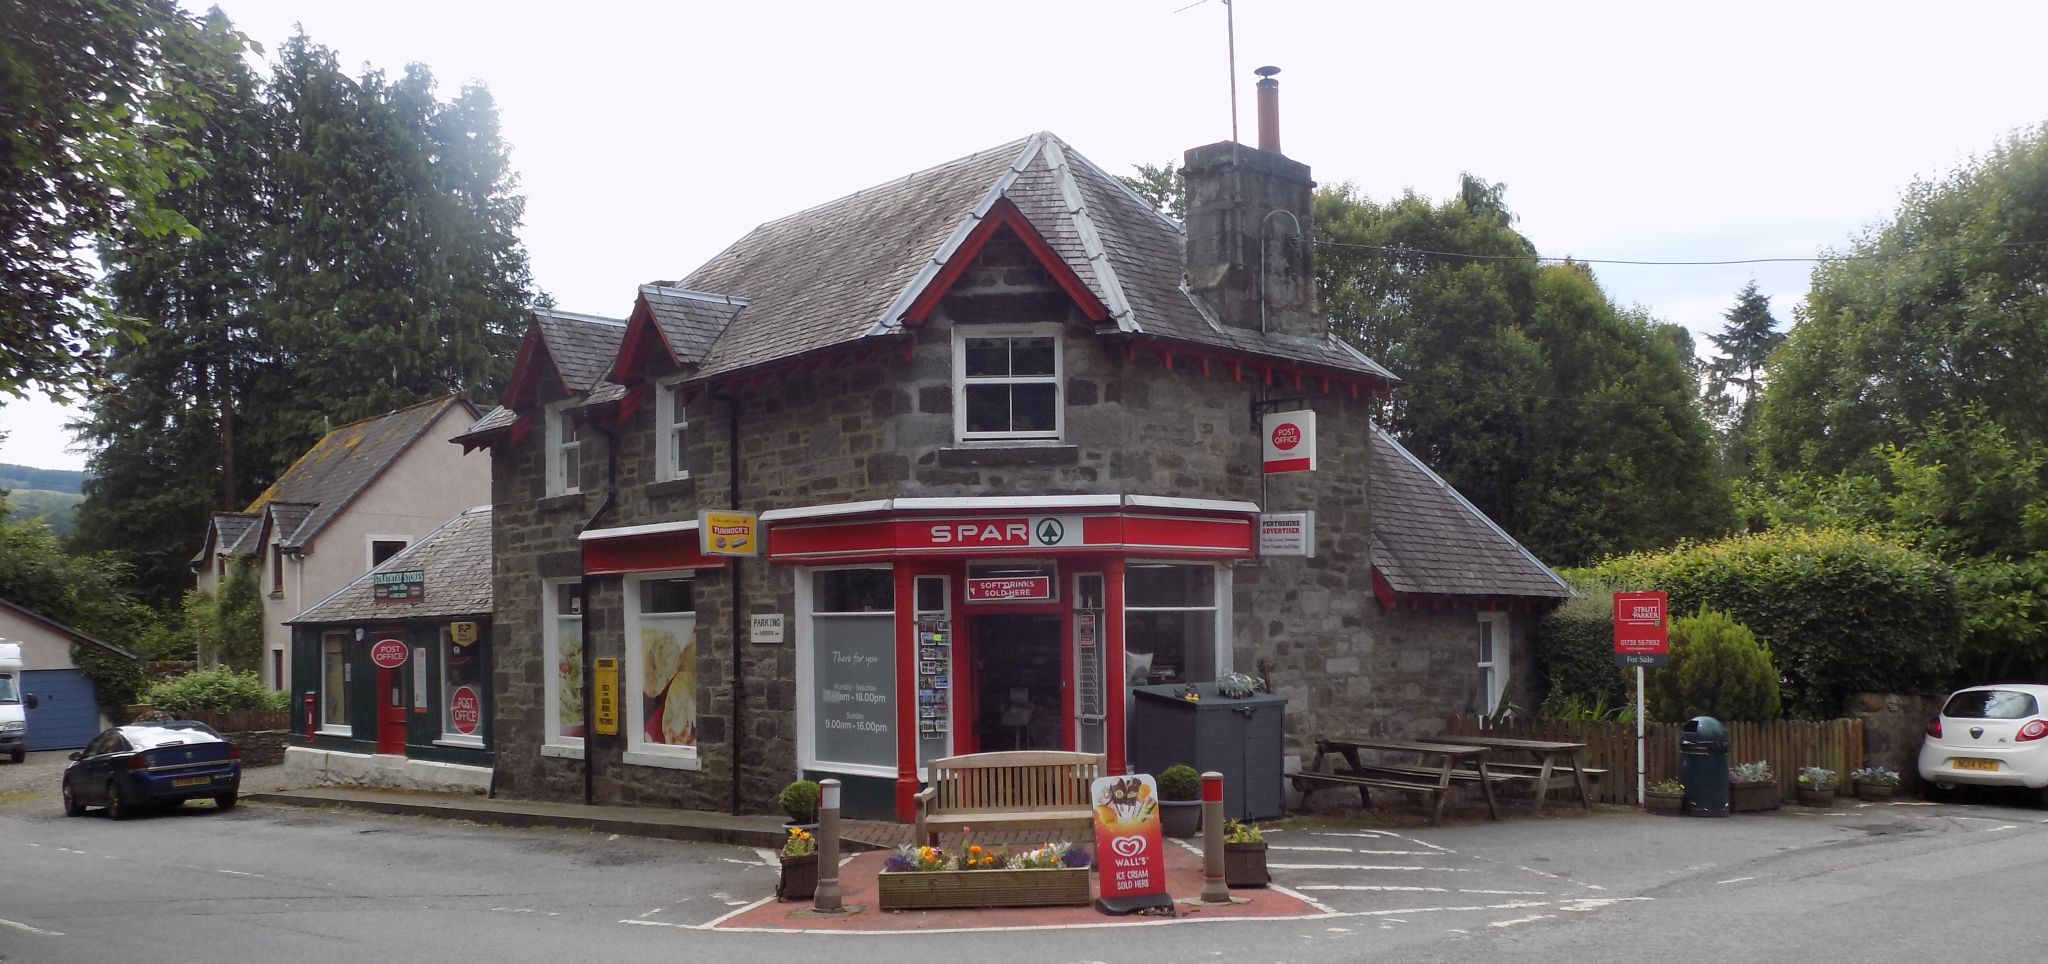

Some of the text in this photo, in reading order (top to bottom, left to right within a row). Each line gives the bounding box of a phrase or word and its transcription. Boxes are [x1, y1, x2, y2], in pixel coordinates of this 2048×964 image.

[1278, 427, 1295, 436] POST
[1274, 435, 1298, 445] OFFICE
[713, 526, 749, 535] TUNNOCK'S
[931, 523, 1027, 543] SPAR
[1262, 527, 1300, 535] ADVERTISER
[375, 571, 423, 584] STRATHTAY STORES
[1003, 580, 1035, 589] DRINKS
[1009, 588, 1031, 597] HERE
[753, 618, 781, 628] PARKING
[380, 645, 400, 653] POST
[376, 652, 404, 661] OFFICE
[832, 651, 852, 664] There
[852, 652, 862, 666] for
[1638, 655, 1654, 663] Sale
[833, 683, 853, 691] Monday
[856, 683, 876, 692] Saturday
[458, 697, 473, 709] POST
[855, 692, 886, 704] 18.00pm
[454, 709, 477, 722] OFFICE
[846, 711, 864, 720] Sunday
[825, 719, 851, 729] 9.00am
[856, 721, 887, 733] 16.00pm
[1115, 857, 1147, 867] WALL'S
[1116, 870, 1149, 880] ICE CREAM
[1117, 879, 1149, 890] SOLD HERE
